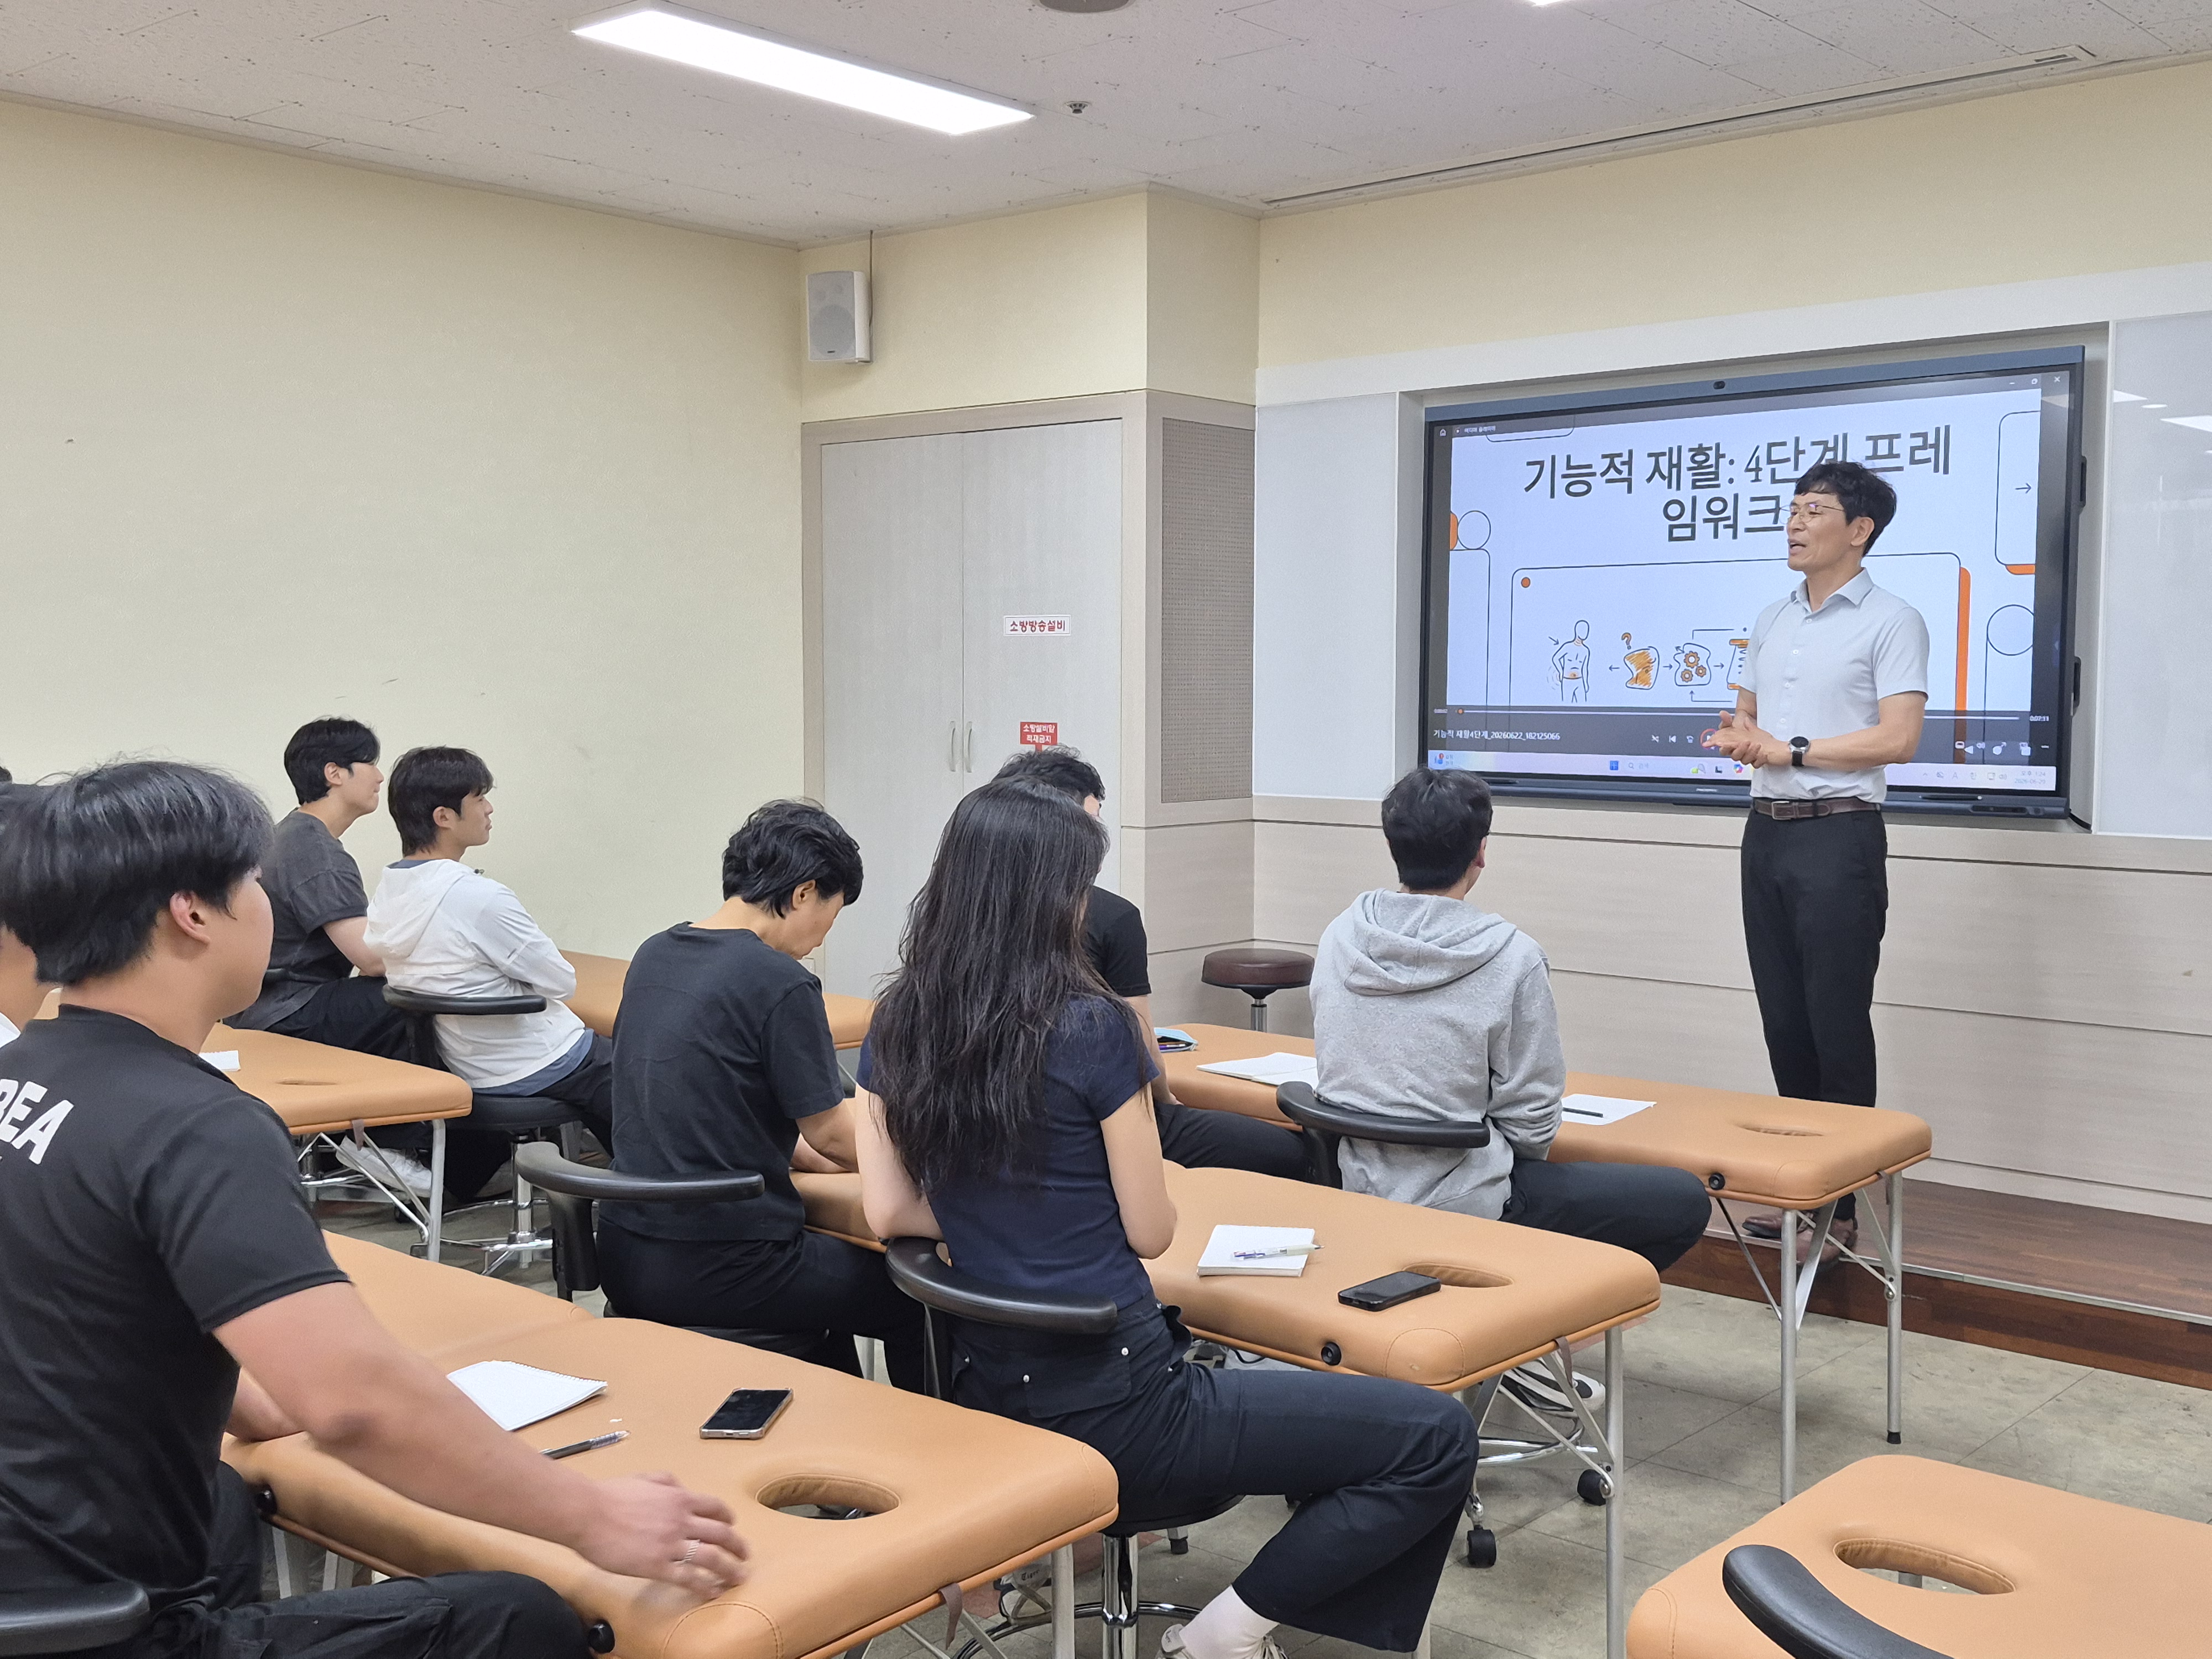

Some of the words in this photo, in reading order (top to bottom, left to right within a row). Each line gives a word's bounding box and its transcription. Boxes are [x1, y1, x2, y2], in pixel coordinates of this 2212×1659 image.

[1524, 448, 1633, 499] 기능적
[1645, 442, 1735, 491] 재활:
[1865, 425, 1950, 474] 프레
[1662, 493, 1784, 542] 임워크
[1010, 620, 1065, 633] 소방방송설비
